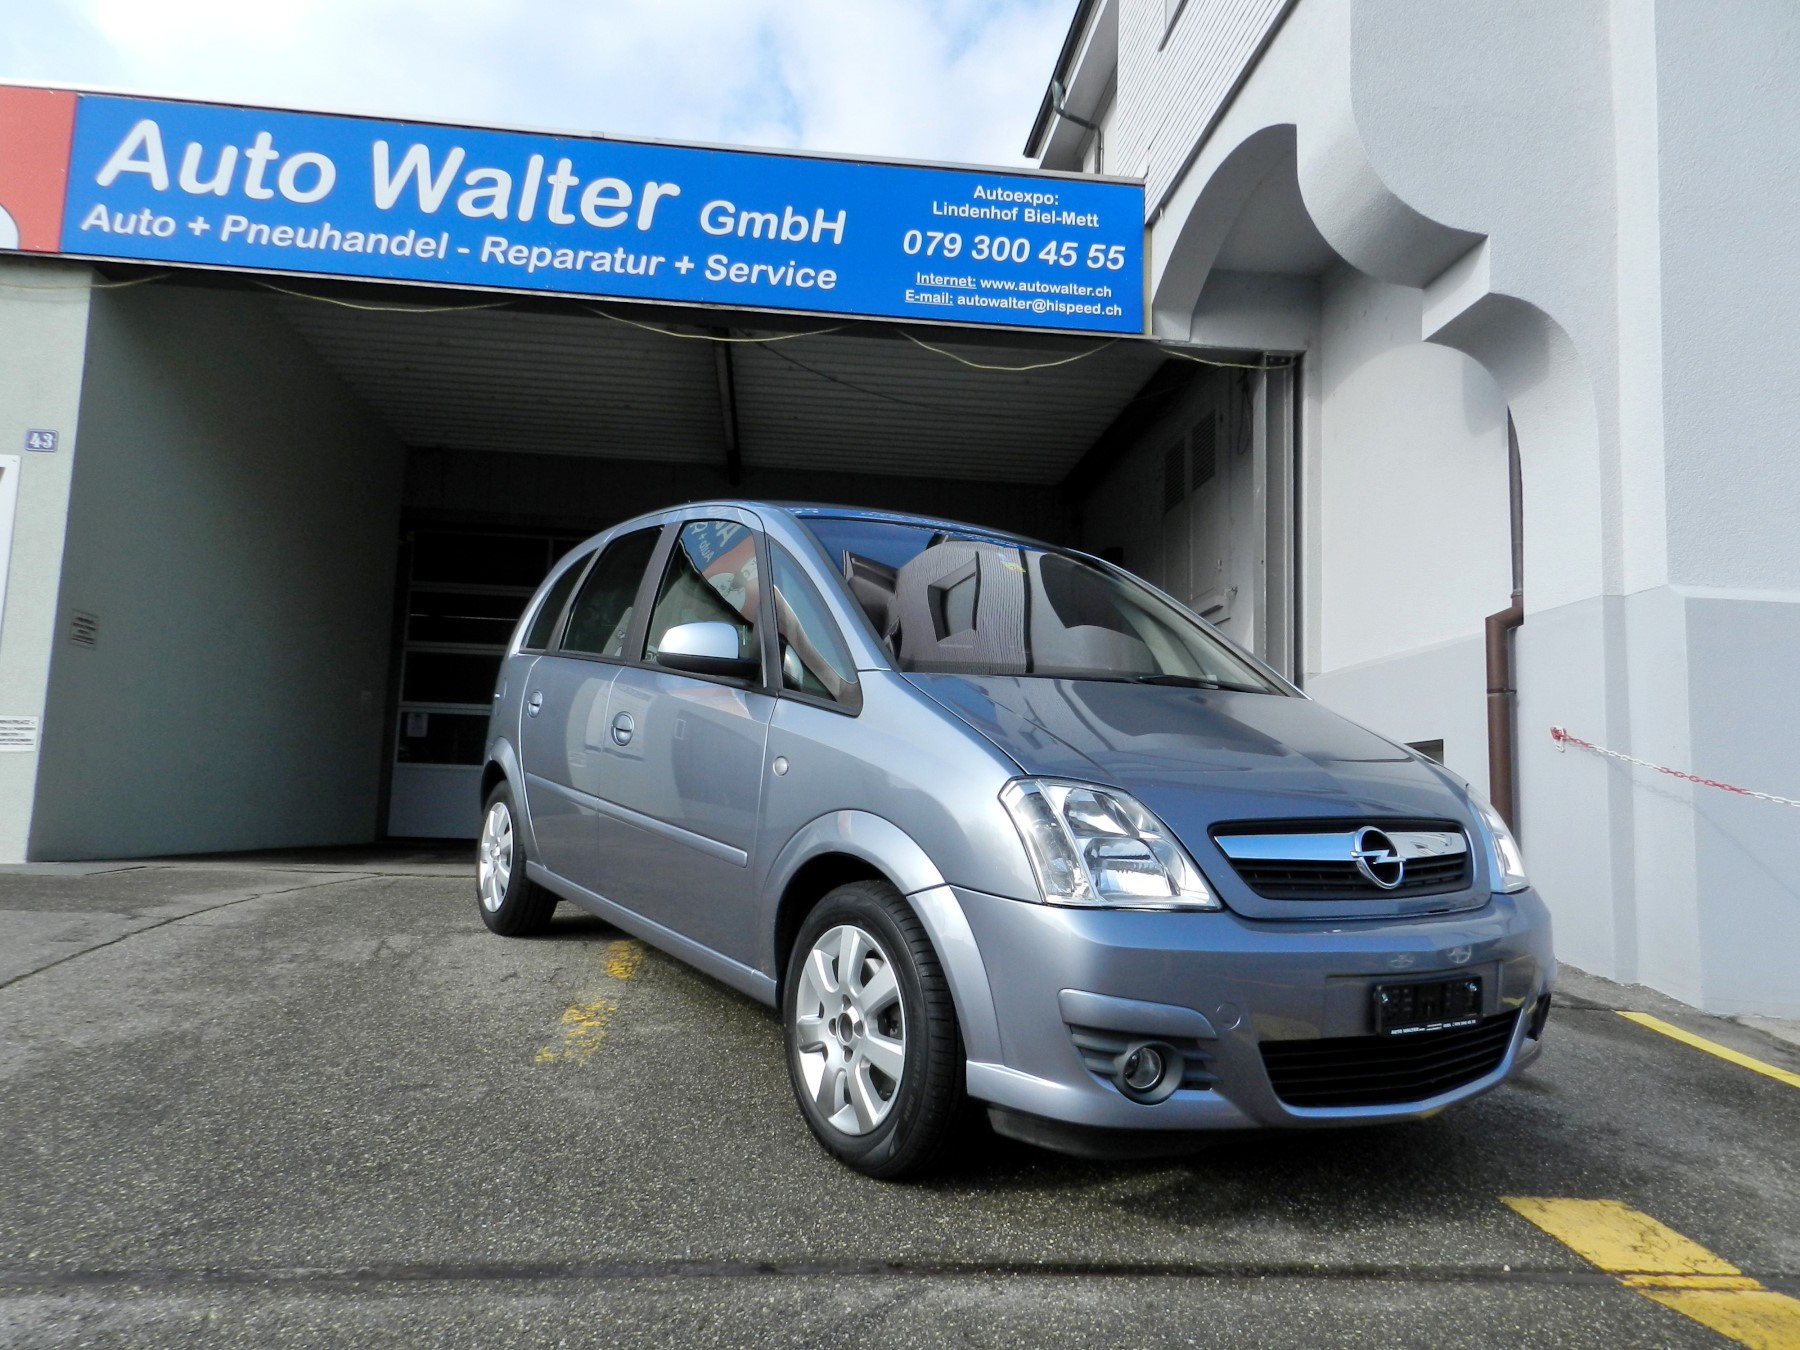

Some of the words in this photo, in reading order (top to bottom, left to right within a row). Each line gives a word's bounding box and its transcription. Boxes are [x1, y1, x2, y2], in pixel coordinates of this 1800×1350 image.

[94, 117, 337, 204] Auto
[371, 139, 681, 232] Walter
[700, 199, 847, 245] GmbH
[972, 185, 1060, 206] Autoexpo:
[931, 200, 1018, 221] Lindenhof
[1023, 208, 1100, 228] Biel-Mett
[80, 203, 177, 238] Auto
[187, 215, 211, 237] +
[219, 214, 449, 260] Pneuhandel
[480, 236, 667, 274] Reparatur
[674, 255, 695, 275] +
[704, 253, 838, 290] Service
[902, 229, 963, 258] 079
[971, 234, 1031, 263] 300
[1038, 240, 1079, 267] 45
[1086, 243, 1126, 270] 55
[916, 272, 977, 289] Internet:
[979, 278, 1112, 298] www.autowalter.ch
[905, 290, 954, 306] E-mail:
[957, 295, 1122, 316] autowalter@hispeed.ch
[28, 431, 54, 449] 43
